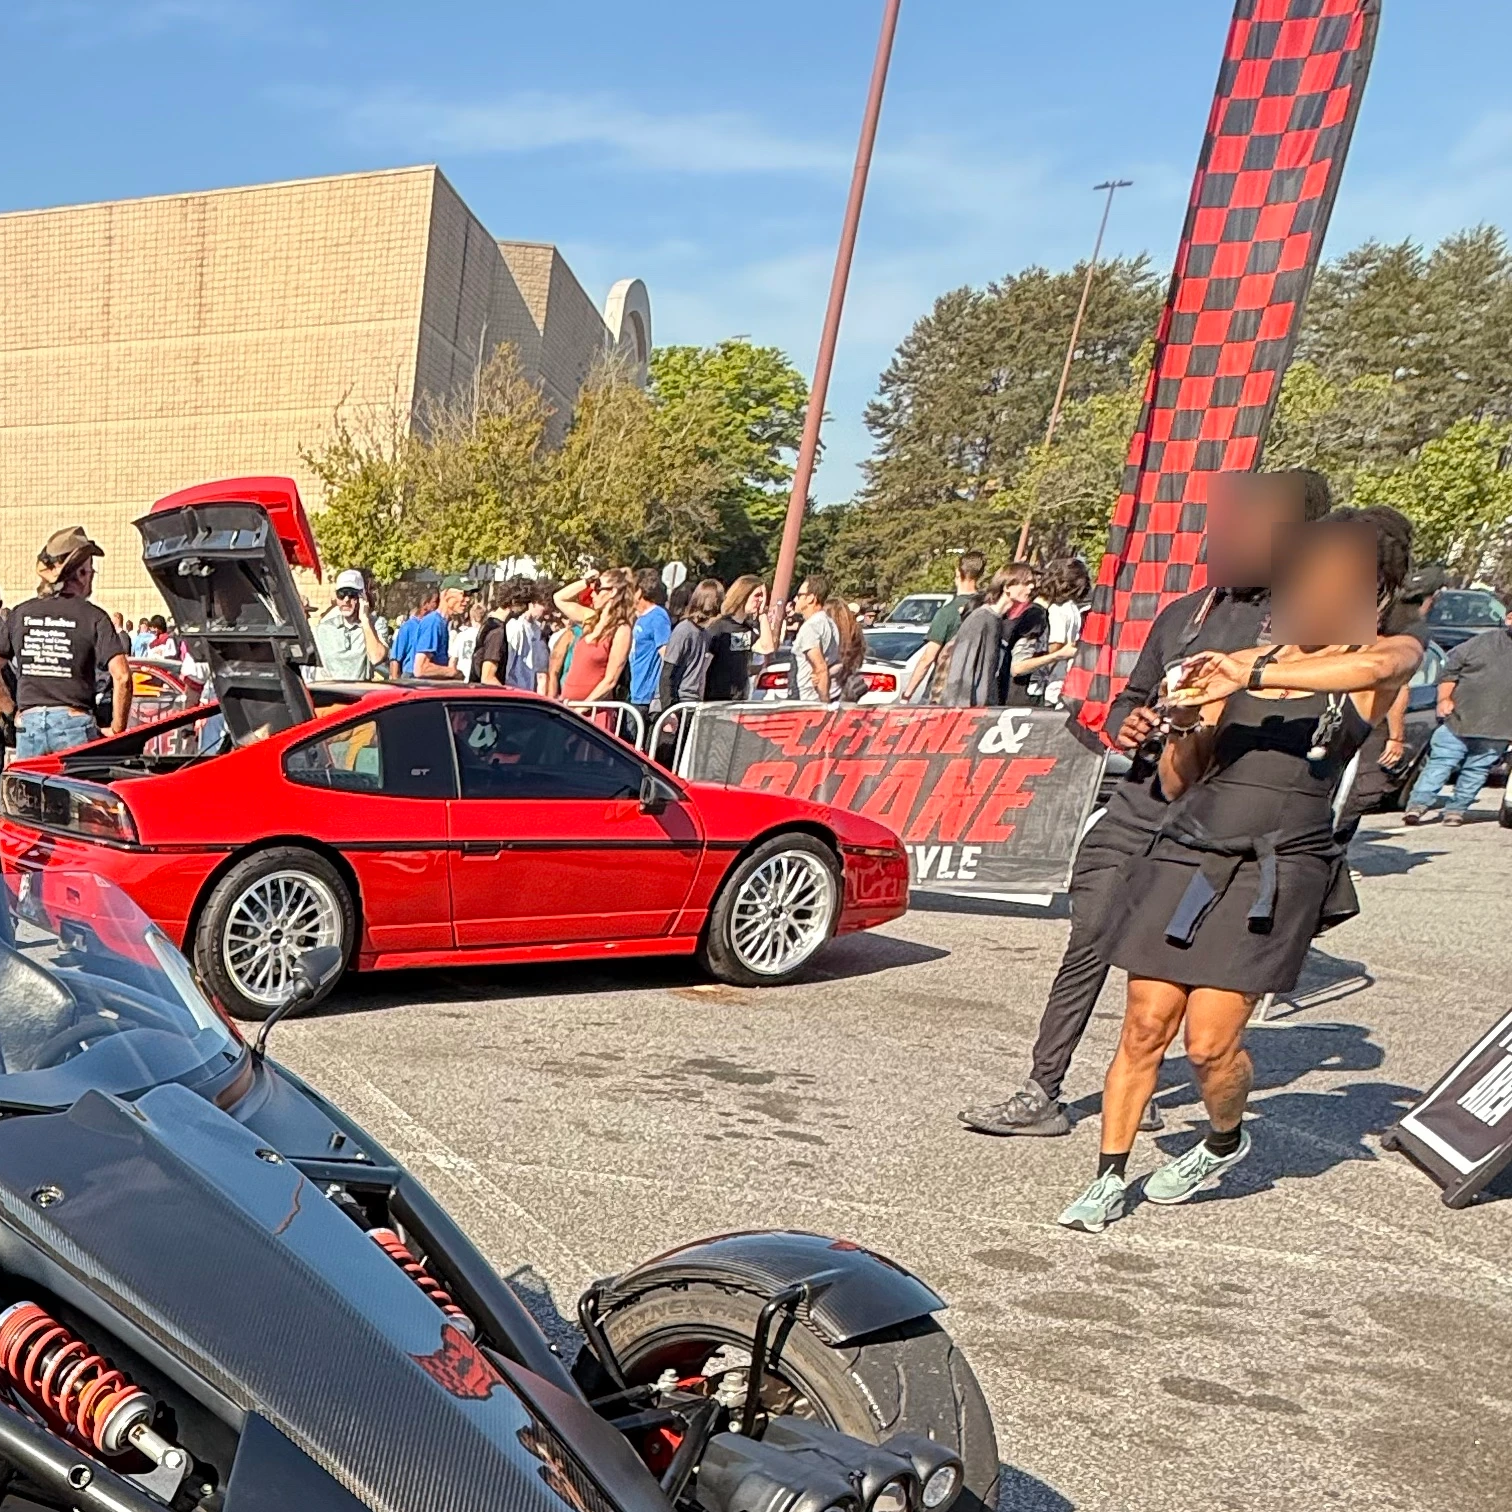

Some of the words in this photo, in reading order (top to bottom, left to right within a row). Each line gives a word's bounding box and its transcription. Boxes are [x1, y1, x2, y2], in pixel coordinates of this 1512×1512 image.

[774, 707, 987, 757] CAFFEINE
[978, 708, 1034, 754] &
[908, 846, 982, 880] YLE
